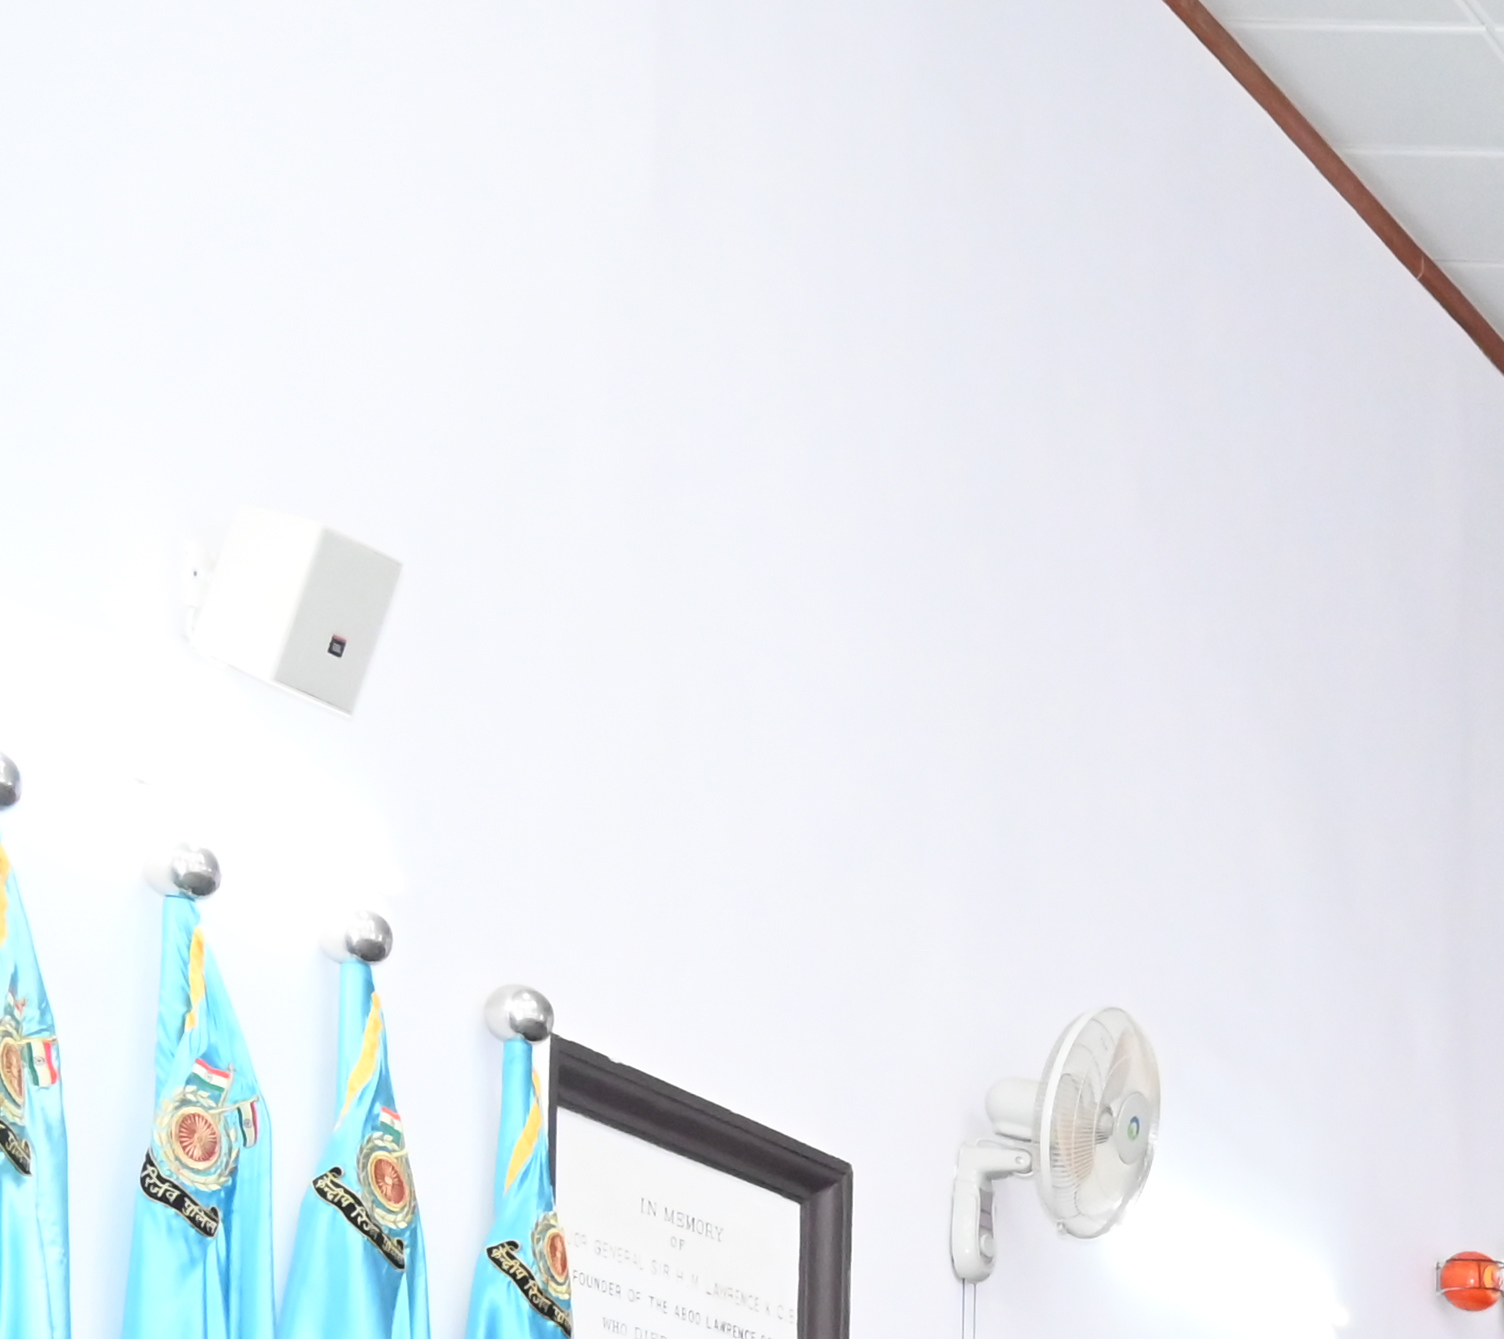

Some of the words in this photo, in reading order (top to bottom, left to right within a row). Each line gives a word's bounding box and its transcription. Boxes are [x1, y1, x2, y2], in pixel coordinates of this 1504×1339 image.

[640, 1198, 657, 1217] IN
[664, 1207, 723, 1242] MEMORY
[670, 1236, 685, 1250] OF
[573, 1270, 621, 1297] FOUNDER
[649, 1295, 668, 1314] THE
[602, 1317, 627, 1336] WHO
